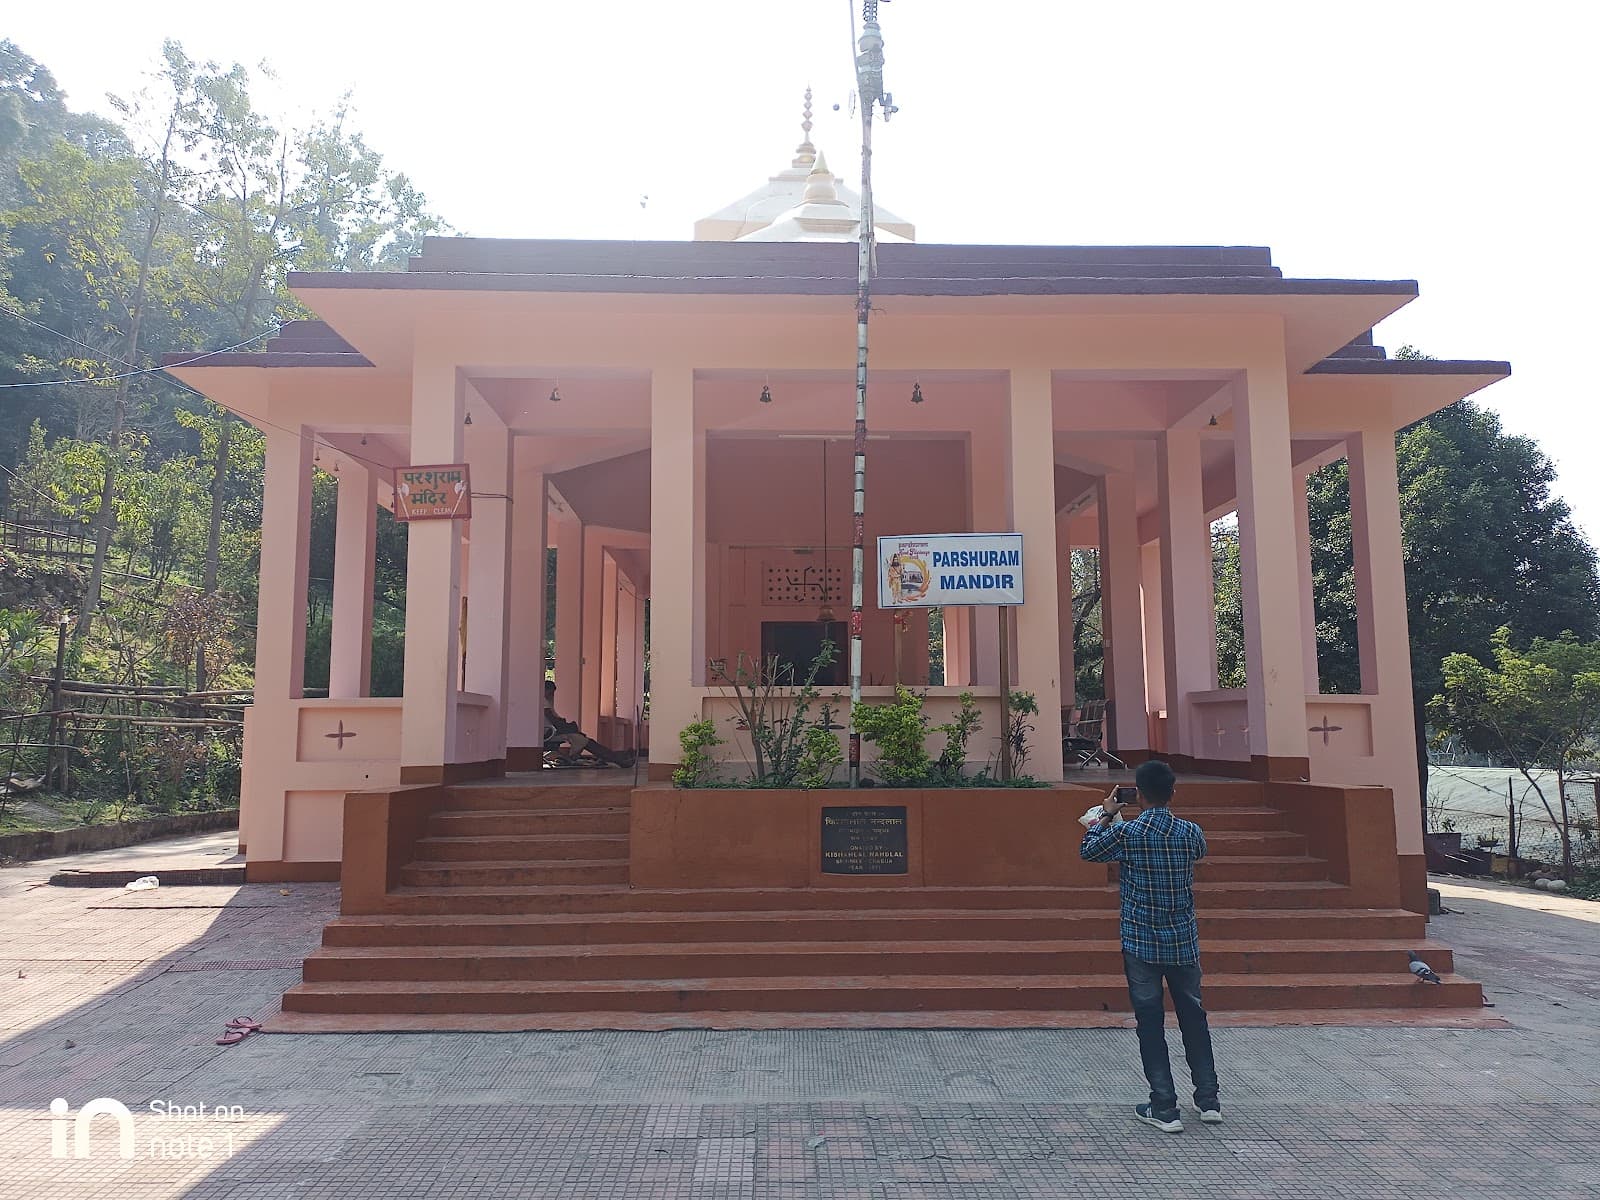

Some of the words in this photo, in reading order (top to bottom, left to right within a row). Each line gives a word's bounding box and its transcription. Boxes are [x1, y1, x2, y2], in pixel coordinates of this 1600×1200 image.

[409, 488, 449, 506] मंदिर
[933, 550, 1020, 567] PARSHURAM
[940, 574, 1014, 589] MANDIR
